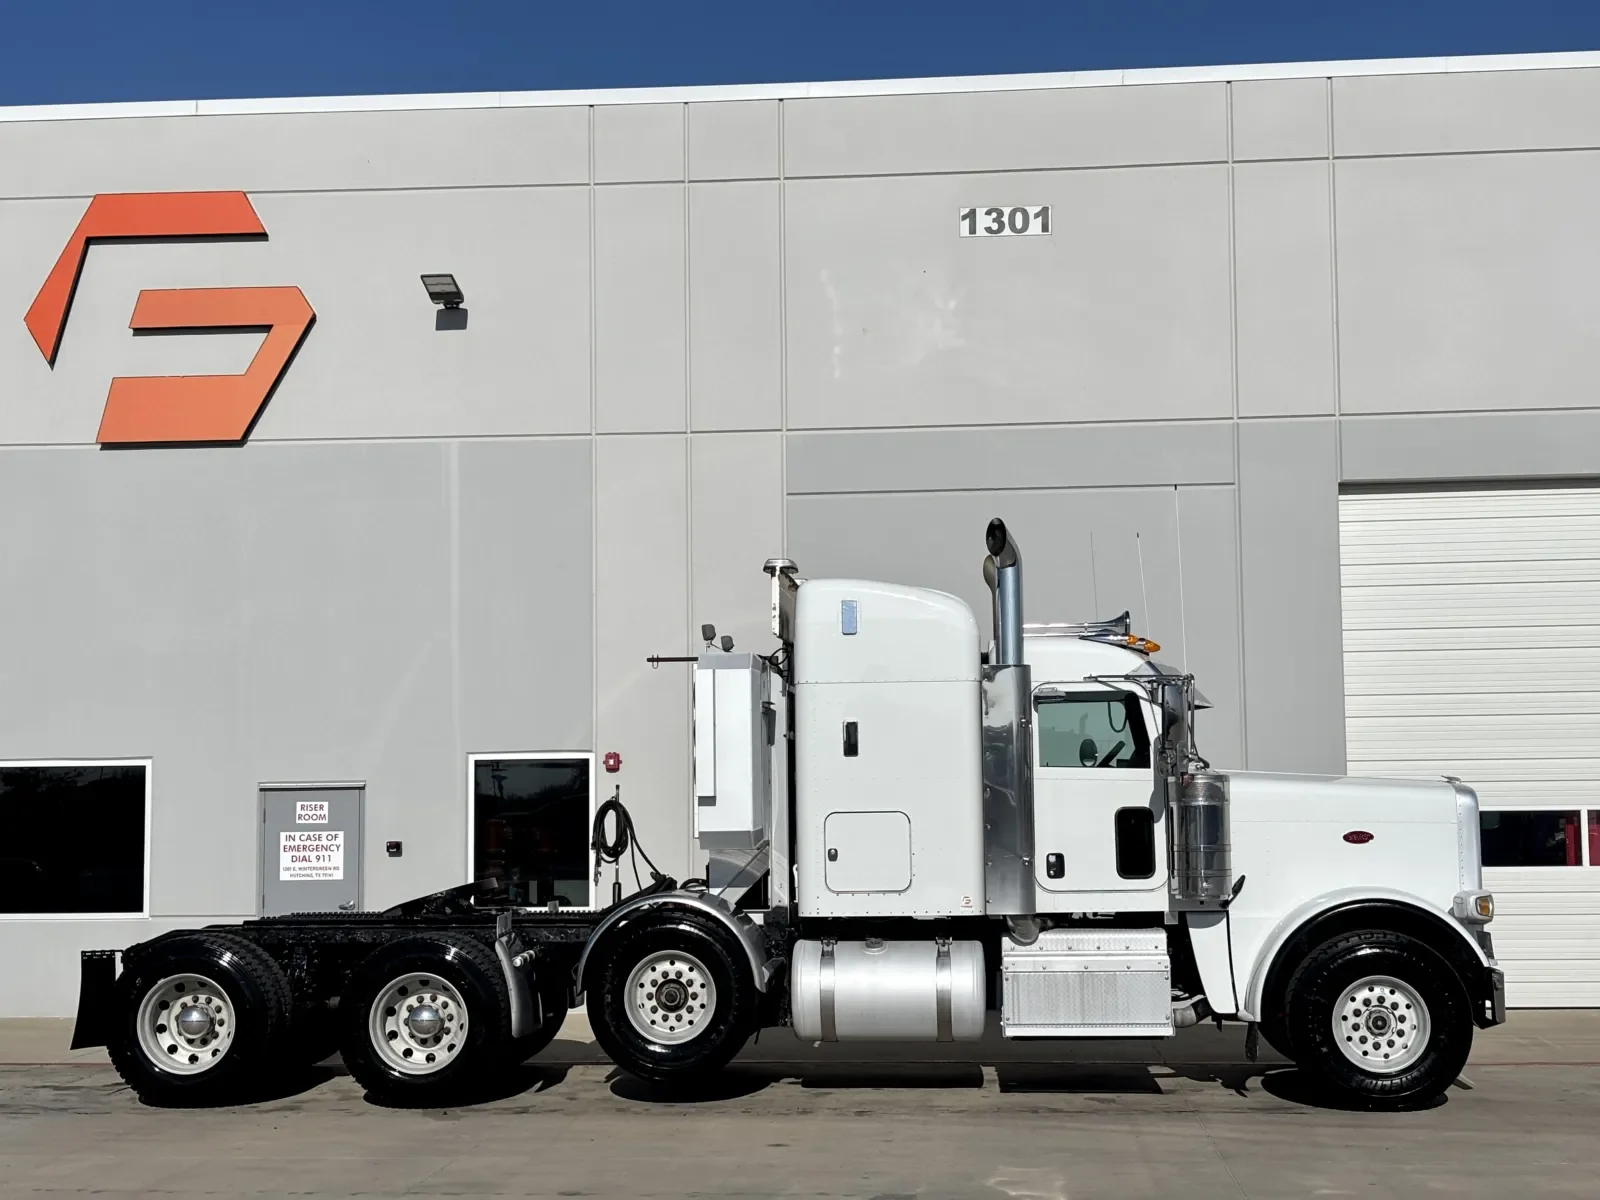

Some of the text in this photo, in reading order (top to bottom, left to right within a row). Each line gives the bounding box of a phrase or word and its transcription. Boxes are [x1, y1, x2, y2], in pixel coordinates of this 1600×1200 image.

[961, 206, 1050, 235] 1301
[298, 813, 327, 821] ROOM
[285, 833, 339, 842] IN CASE OF
[283, 844, 341, 852] EMERGENCY
[315, 854, 331, 862] 911
